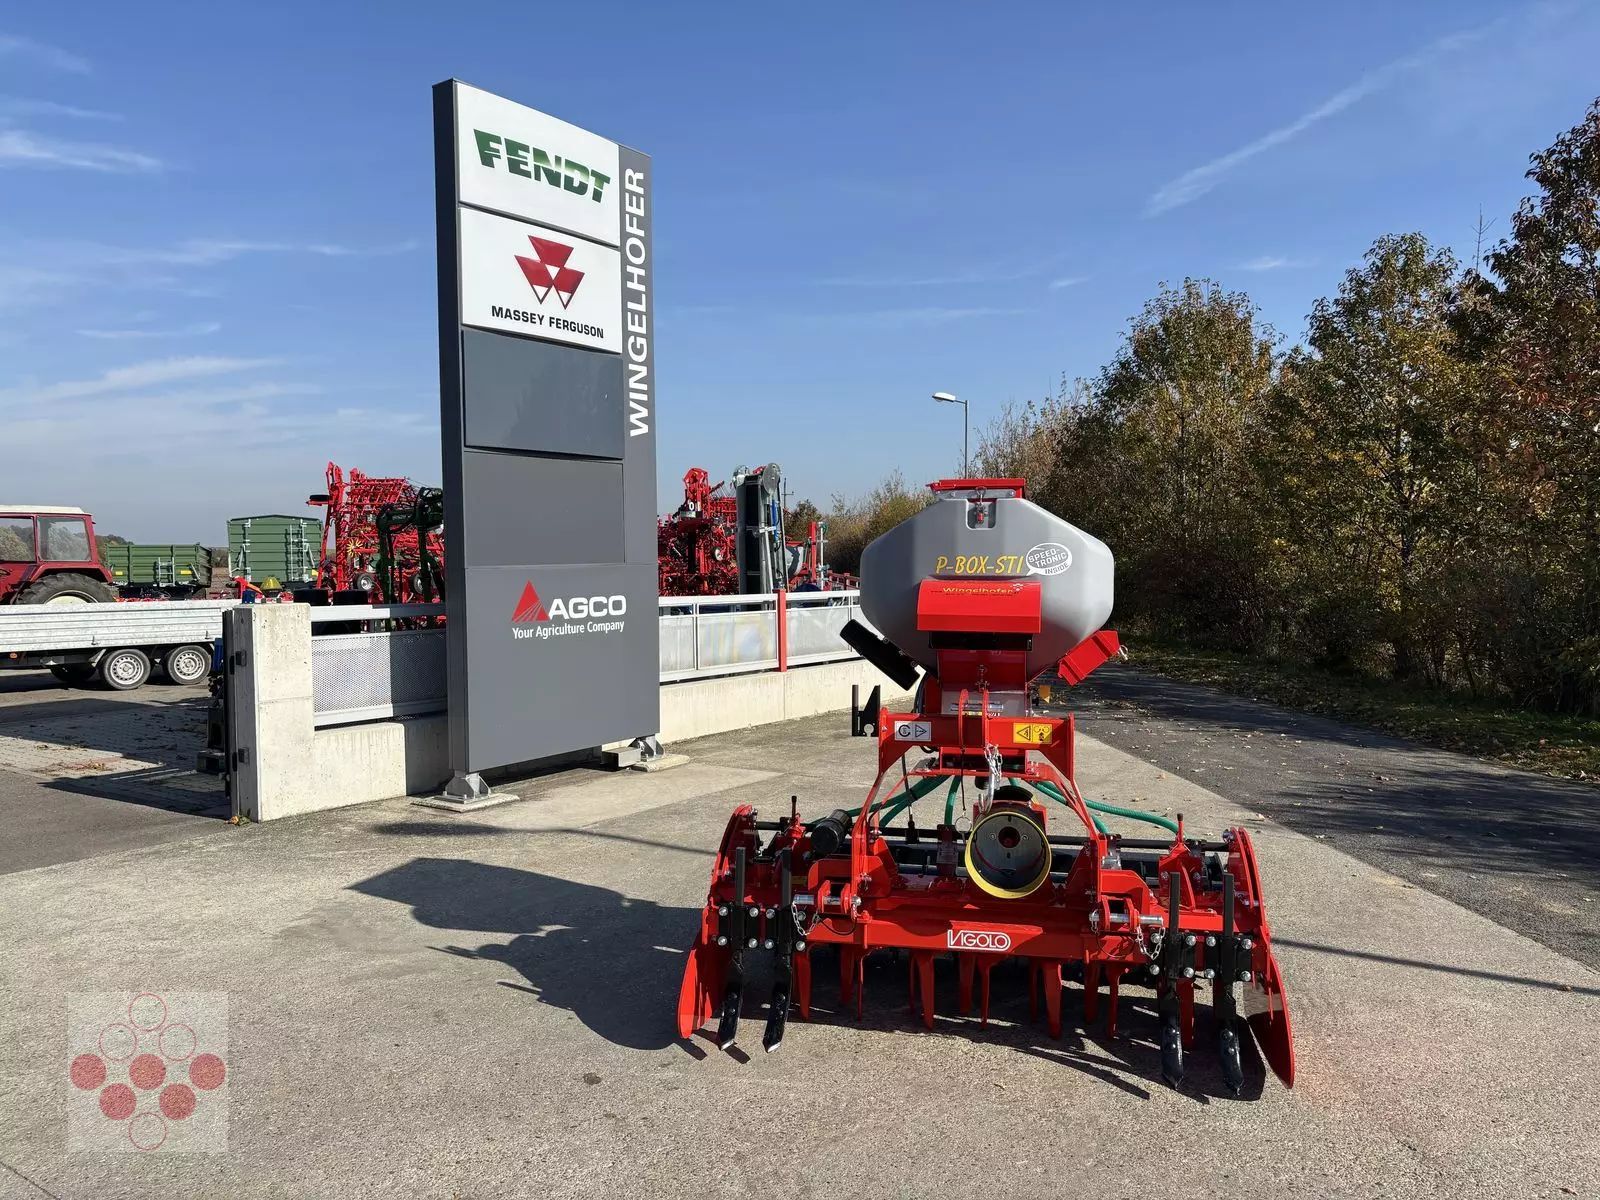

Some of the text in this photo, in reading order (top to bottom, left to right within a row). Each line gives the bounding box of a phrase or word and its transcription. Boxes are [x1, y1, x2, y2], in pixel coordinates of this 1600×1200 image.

[473, 128, 611, 203] FENDT
[624, 168, 649, 437] WINGELHOFER
[491, 305, 604, 339] MASSEY FERGUSON
[936, 555, 1024, 574] P-BOX-STI
[1035, 552, 1067, 568] TRONIC
[1045, 562, 1070, 574] INSIDE
[943, 587, 1013, 595] Wingelhofer
[549, 595, 627, 620] AGCO
[512, 620, 625, 639] Your Agriculture Company
